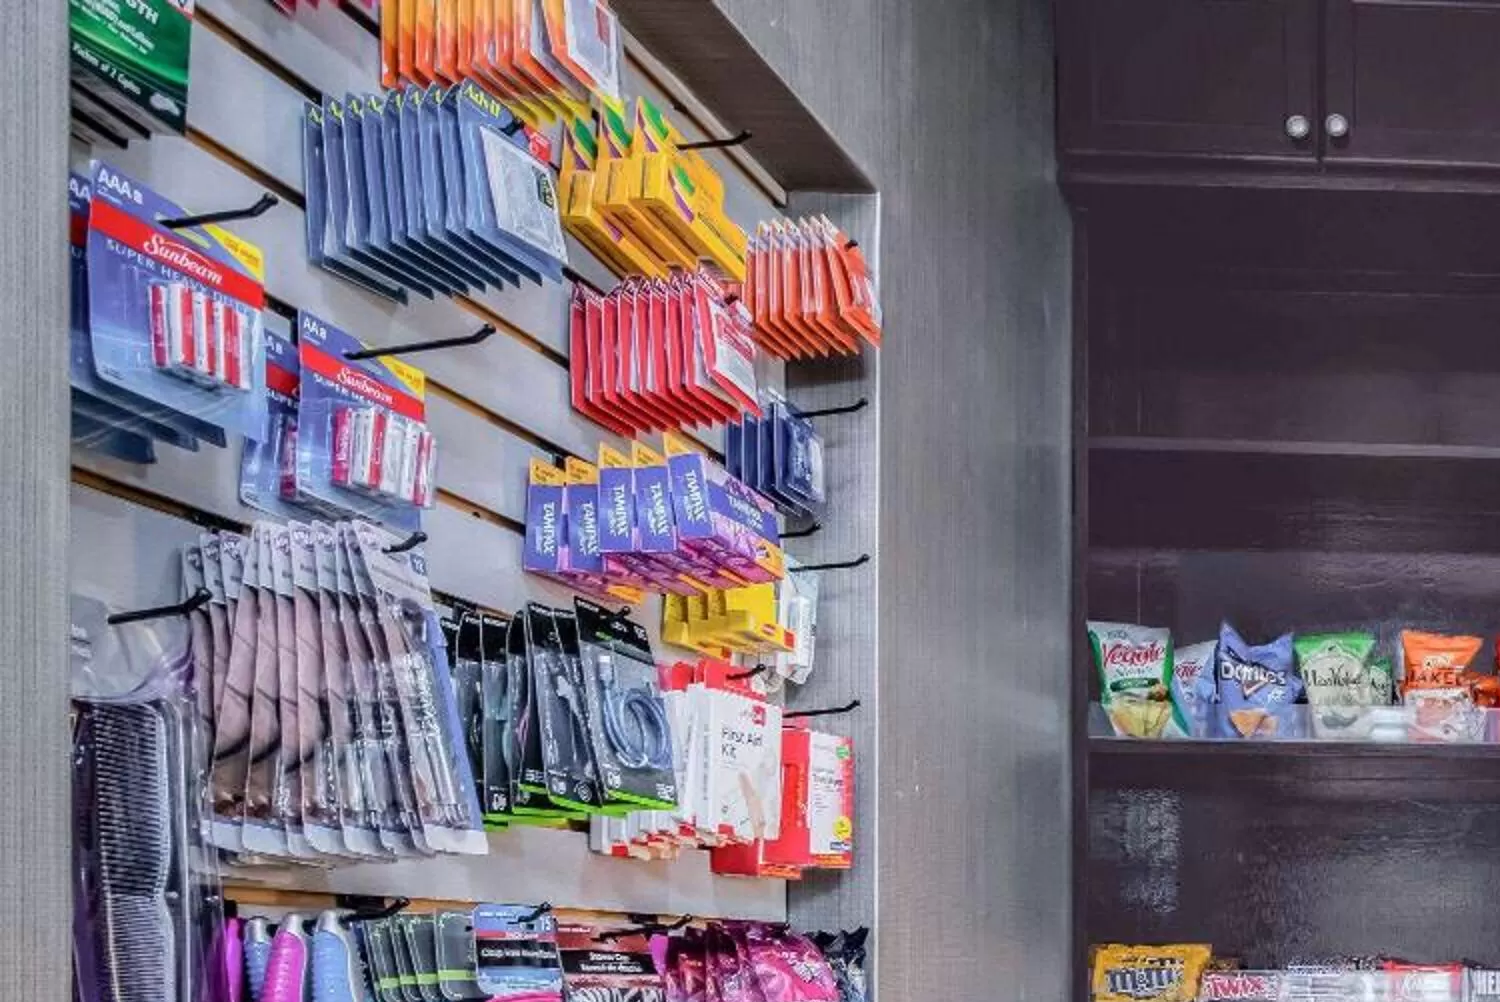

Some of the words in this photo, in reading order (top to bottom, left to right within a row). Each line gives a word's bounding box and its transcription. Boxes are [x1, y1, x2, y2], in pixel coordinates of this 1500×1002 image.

[98, 168, 133, 200] AAA
[143, 232, 224, 286] Sunbeam
[337, 366, 395, 405] Sunbeam
[543, 501, 555, 557] TAMPAX
[1221, 660, 1286, 686] Doritos
[721, 743, 737, 759] Kit
